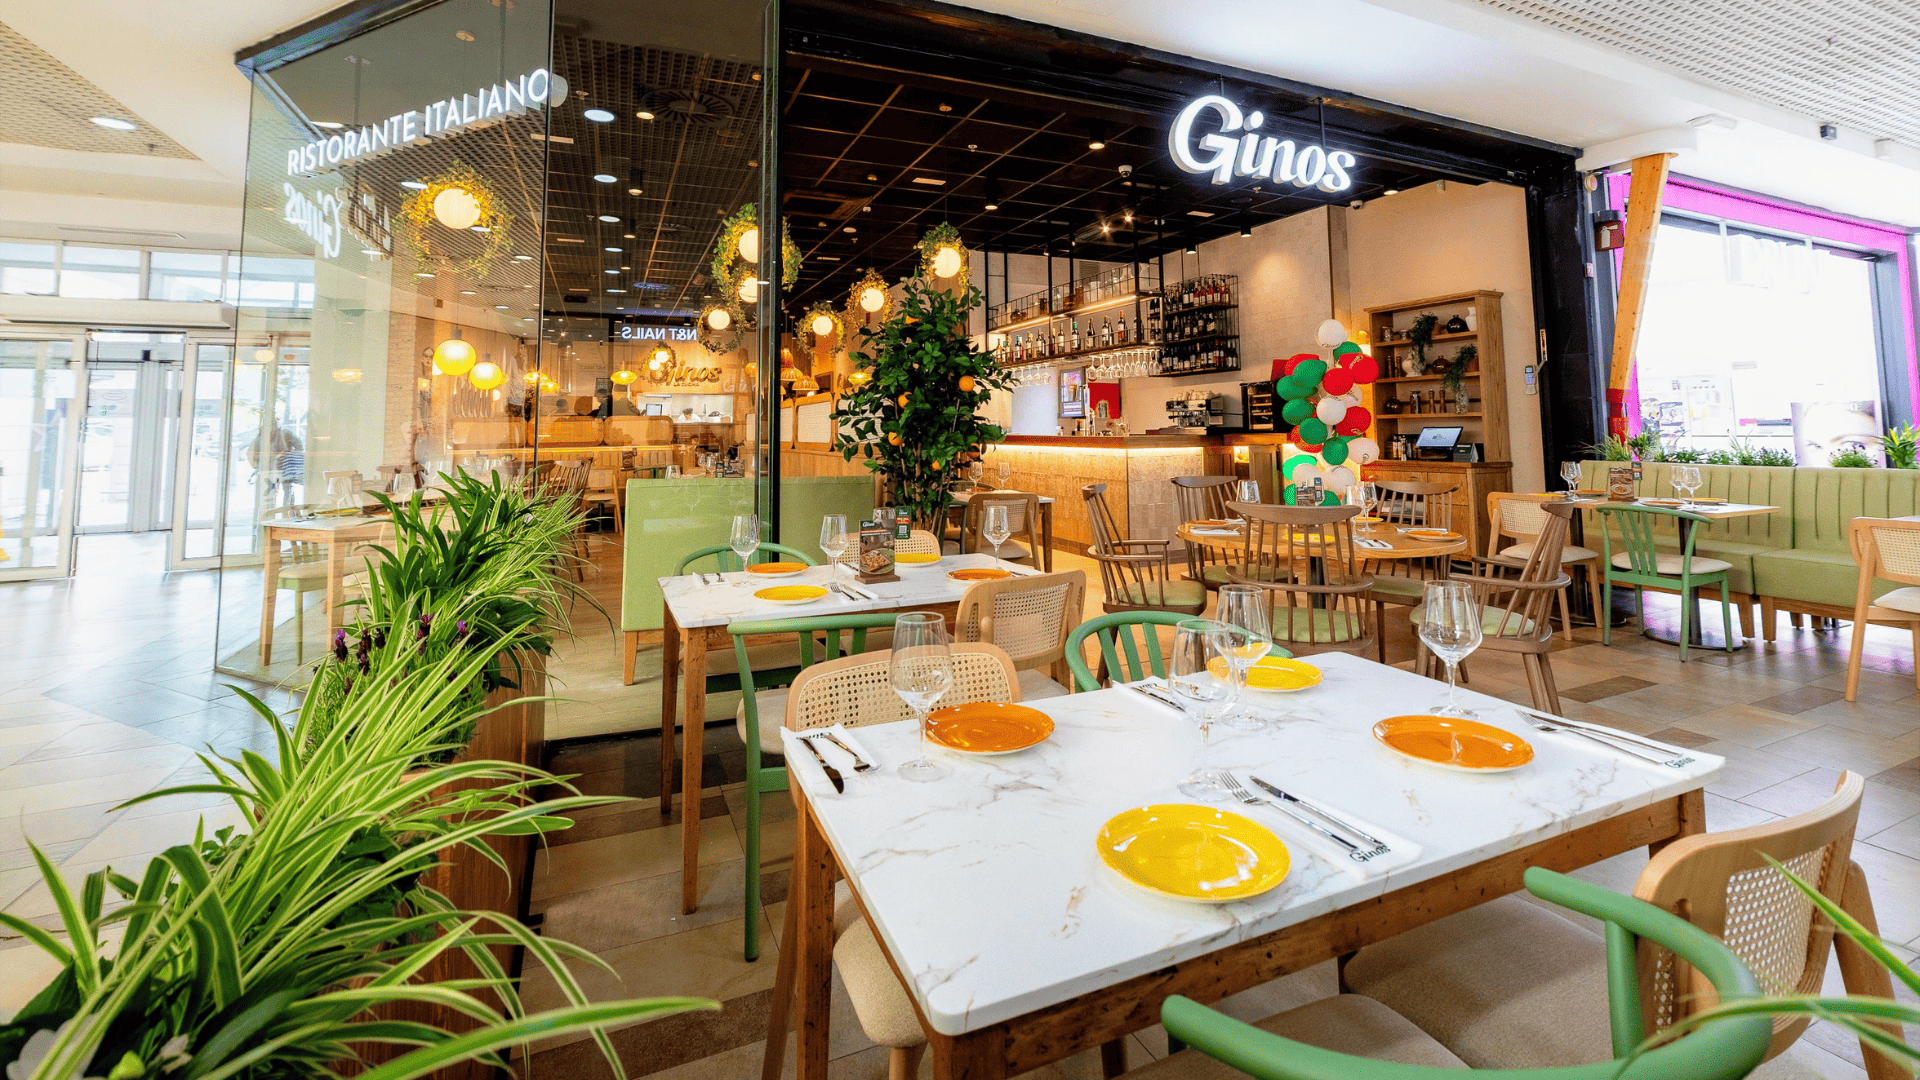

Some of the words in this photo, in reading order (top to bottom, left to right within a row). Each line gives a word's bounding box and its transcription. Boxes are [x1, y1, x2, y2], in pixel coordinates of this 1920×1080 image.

[288, 110, 416, 176] RISTORANTE
[425, 68, 549, 136] ITALIANO
[1169, 95, 1356, 193] Ginos
[1349, 844, 1391, 863] Ginos
